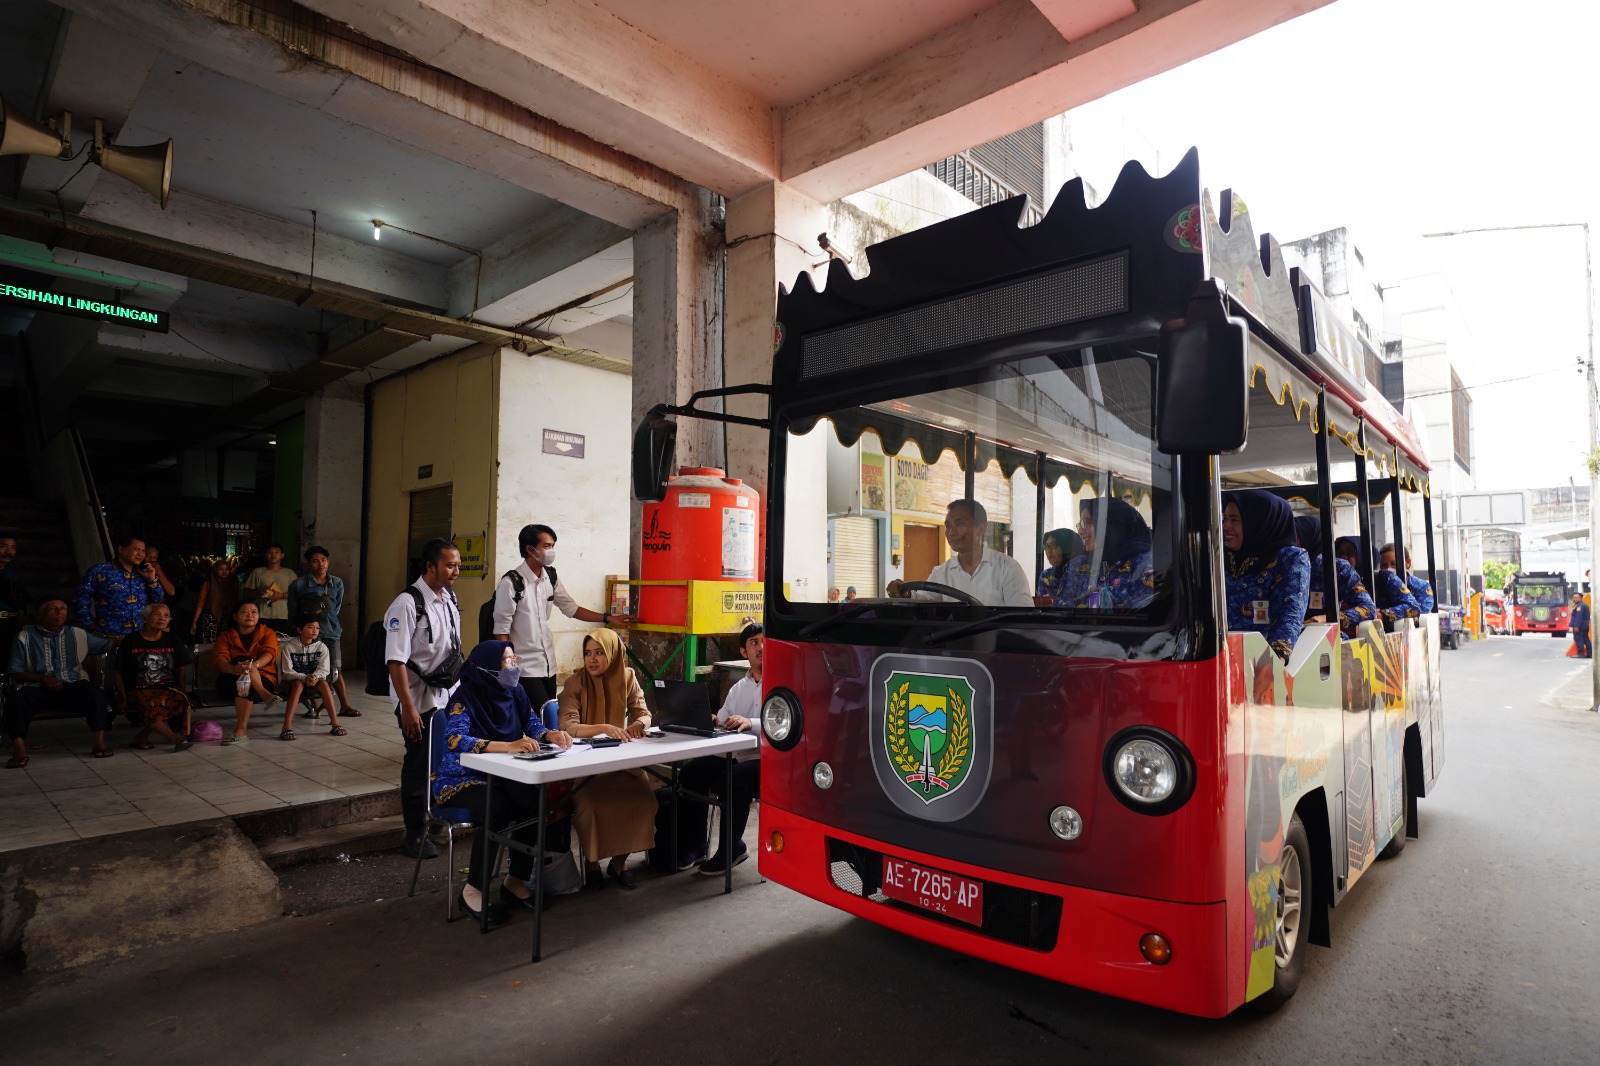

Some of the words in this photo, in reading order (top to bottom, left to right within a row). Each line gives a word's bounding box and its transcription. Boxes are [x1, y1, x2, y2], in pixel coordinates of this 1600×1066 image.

[0, 284, 64, 306] ERSIHAN
[67, 297, 158, 324] LINGKUNGAN
[897, 459, 912, 478] SOTO
[913, 461, 929, 481] DAGI
[886, 861, 904, 888] AE
[911, 868, 952, 901] 7265
[957, 881, 979, 908] AP
